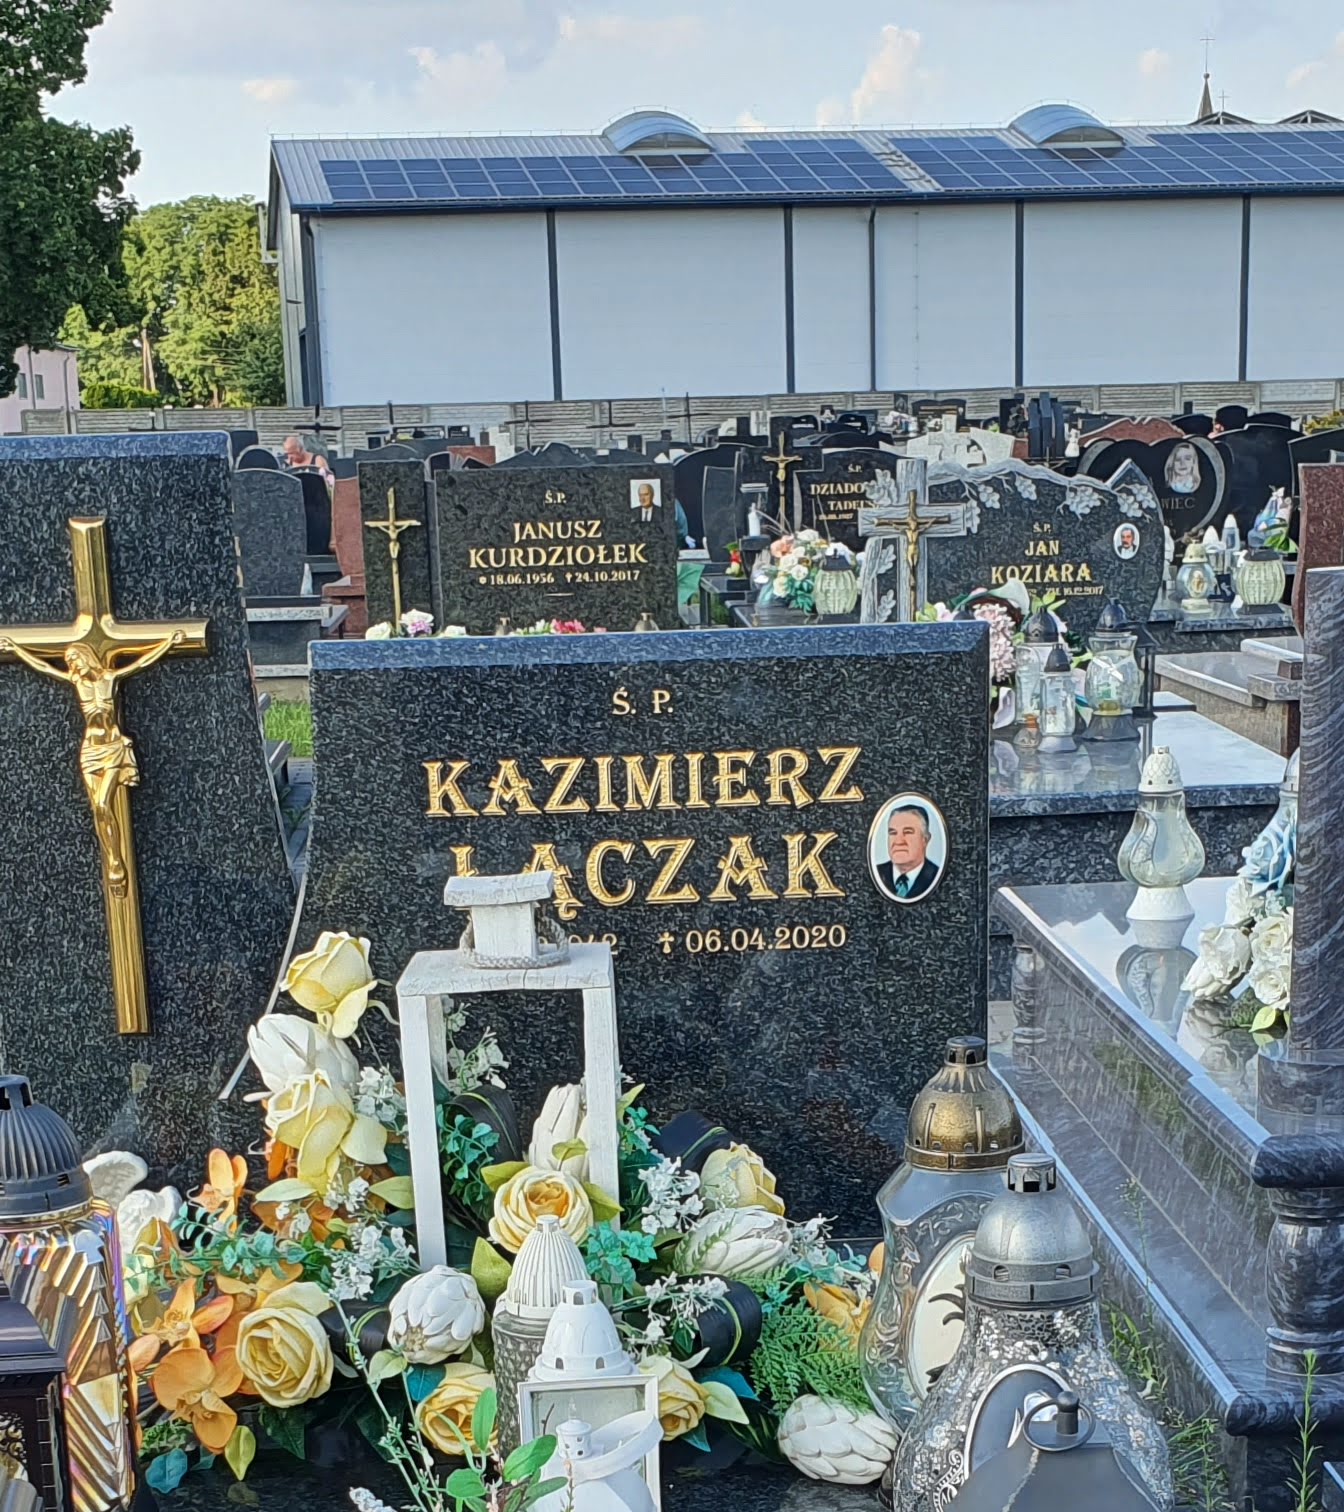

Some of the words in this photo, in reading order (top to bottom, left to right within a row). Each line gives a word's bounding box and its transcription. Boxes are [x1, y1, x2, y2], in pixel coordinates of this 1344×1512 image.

[544, 490, 567, 504] Ś.P.
[810, 482, 866, 495] DZIADO
[513, 520, 603, 543] JANUSZ
[468, 543, 648, 568] KURDZIOŁEK
[1024, 540, 1060, 556] JAN
[490, 572, 555, 585] 18.06.1956
[574, 569, 641, 583] 24.10.2017
[991, 562, 1093, 585] KOZIARA
[652, 689, 675, 715] P.
[421, 746, 865, 818] KAZIMIERZ
[686, 924, 847, 954] 06.04.2020
